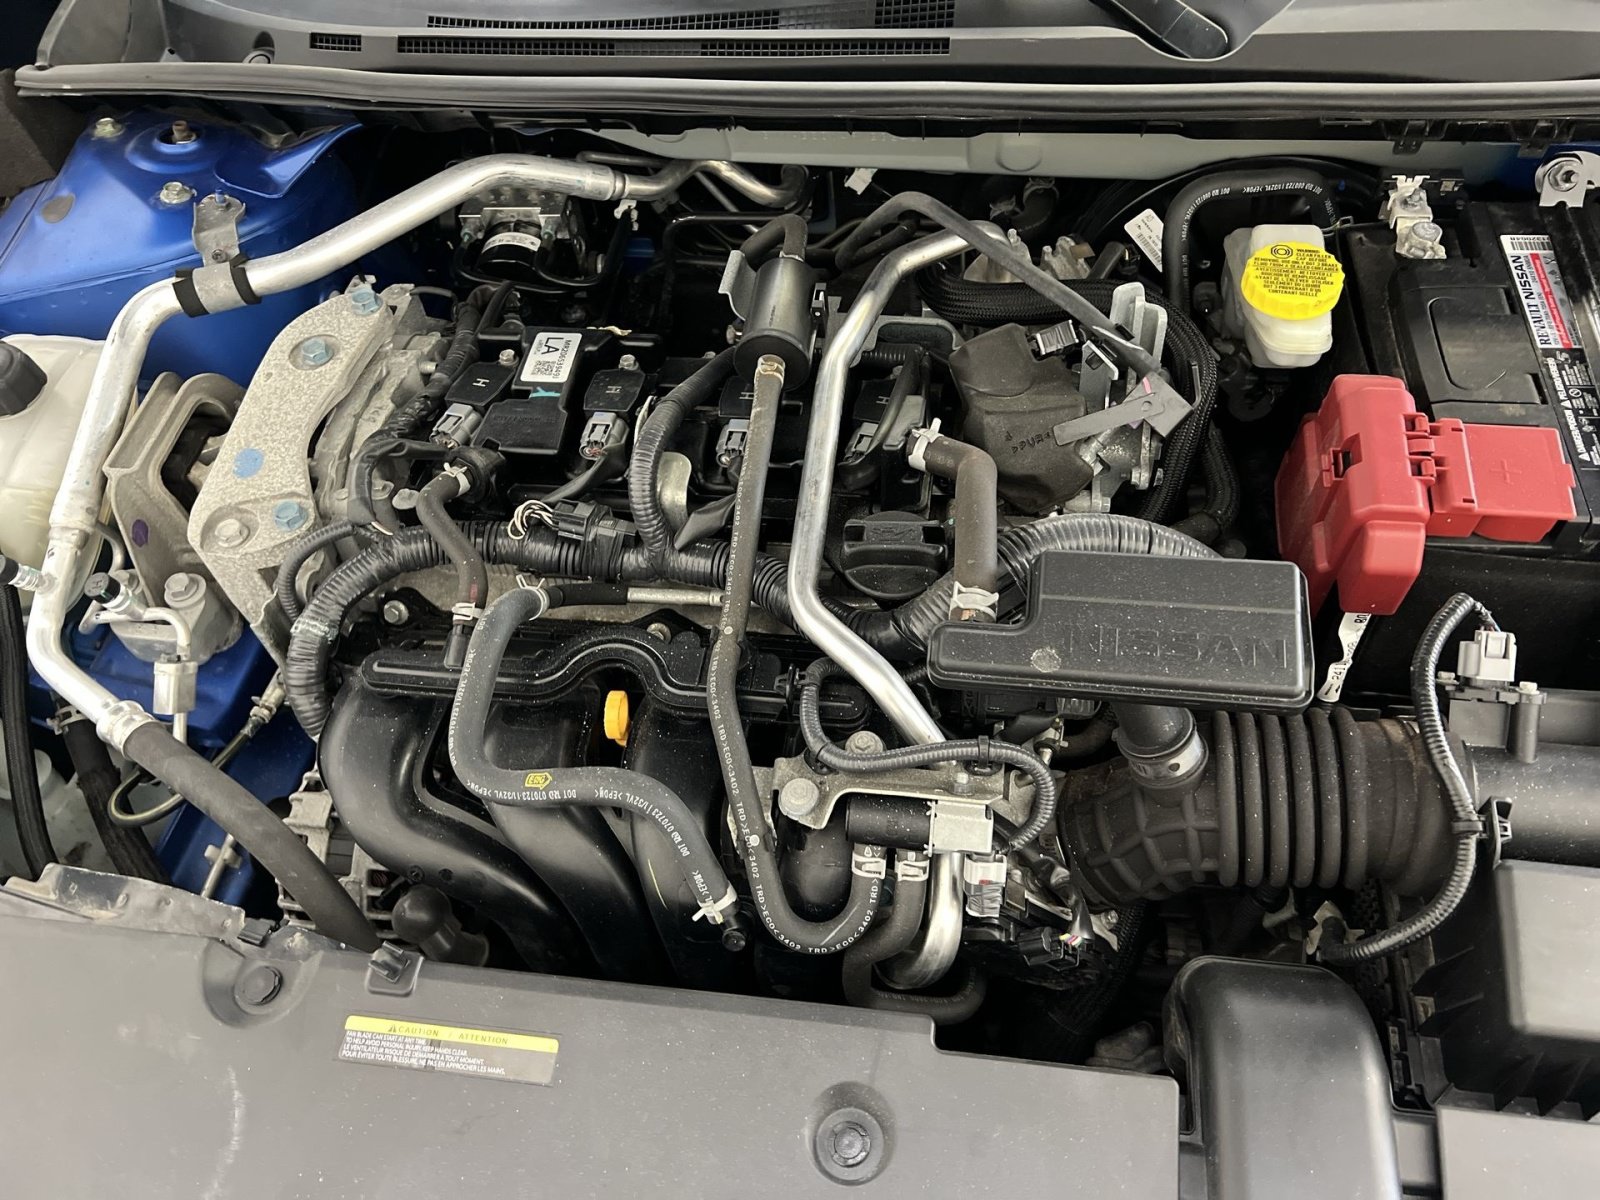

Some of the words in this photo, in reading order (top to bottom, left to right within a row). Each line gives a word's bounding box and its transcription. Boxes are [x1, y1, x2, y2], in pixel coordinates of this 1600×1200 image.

[1510, 255, 1535, 300] NISSAN
[1527, 302, 1552, 345] RENAULT
[541, 337, 564, 355] LA
[472, 378, 490, 387] H
[1064, 624, 1287, 668] NISSAN
[564, 790, 576, 798] DOT
[652, 808, 674, 832] 070723
[678, 844, 690, 857] DOT
[398, 1025, 439, 1036] CAUTION
[459, 1033, 508, 1044] ATTENTION
[351, 1044, 383, 1053] VENTILATEUR
[381, 1040, 404, 1048] PERSONAL
[376, 1054, 391, 1062] TOUTE
[445, 1061, 476, 1071] APPROCHER
